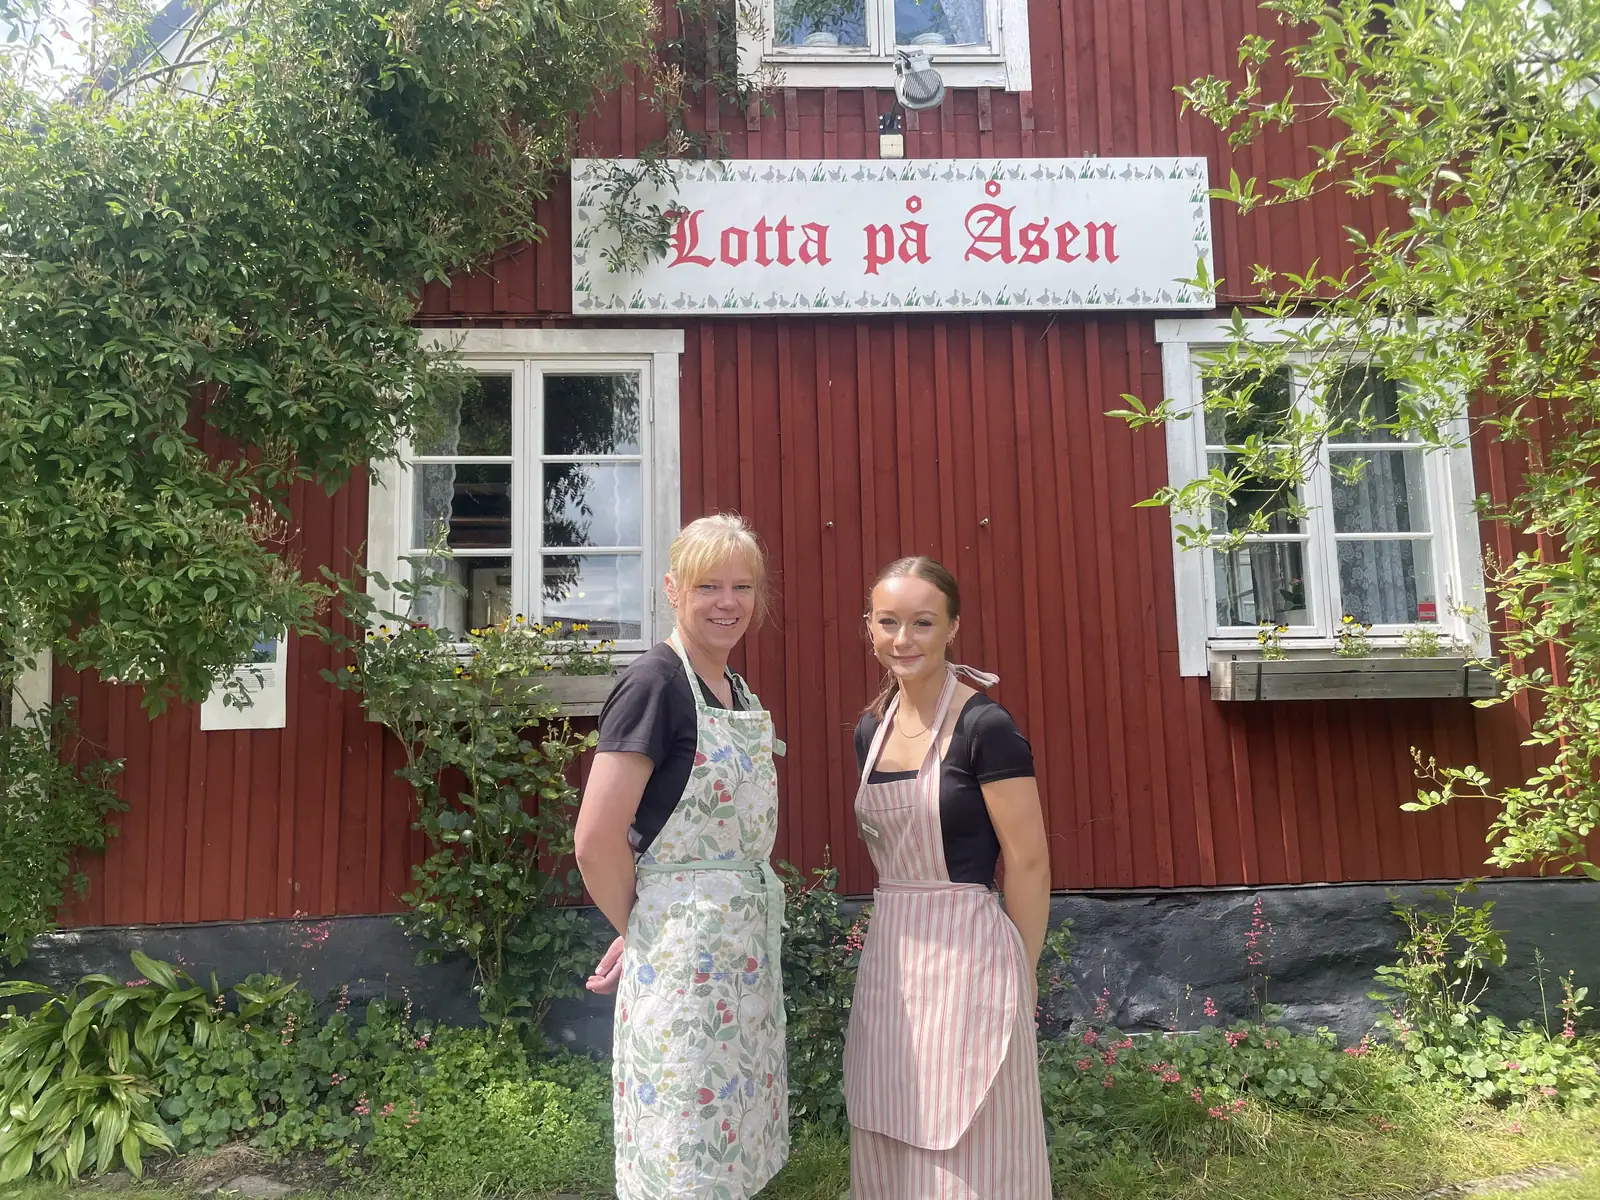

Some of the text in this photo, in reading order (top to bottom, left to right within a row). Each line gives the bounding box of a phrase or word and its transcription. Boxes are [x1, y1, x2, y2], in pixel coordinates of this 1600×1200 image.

[664, 180, 1119, 275] Lotta på Åsen
